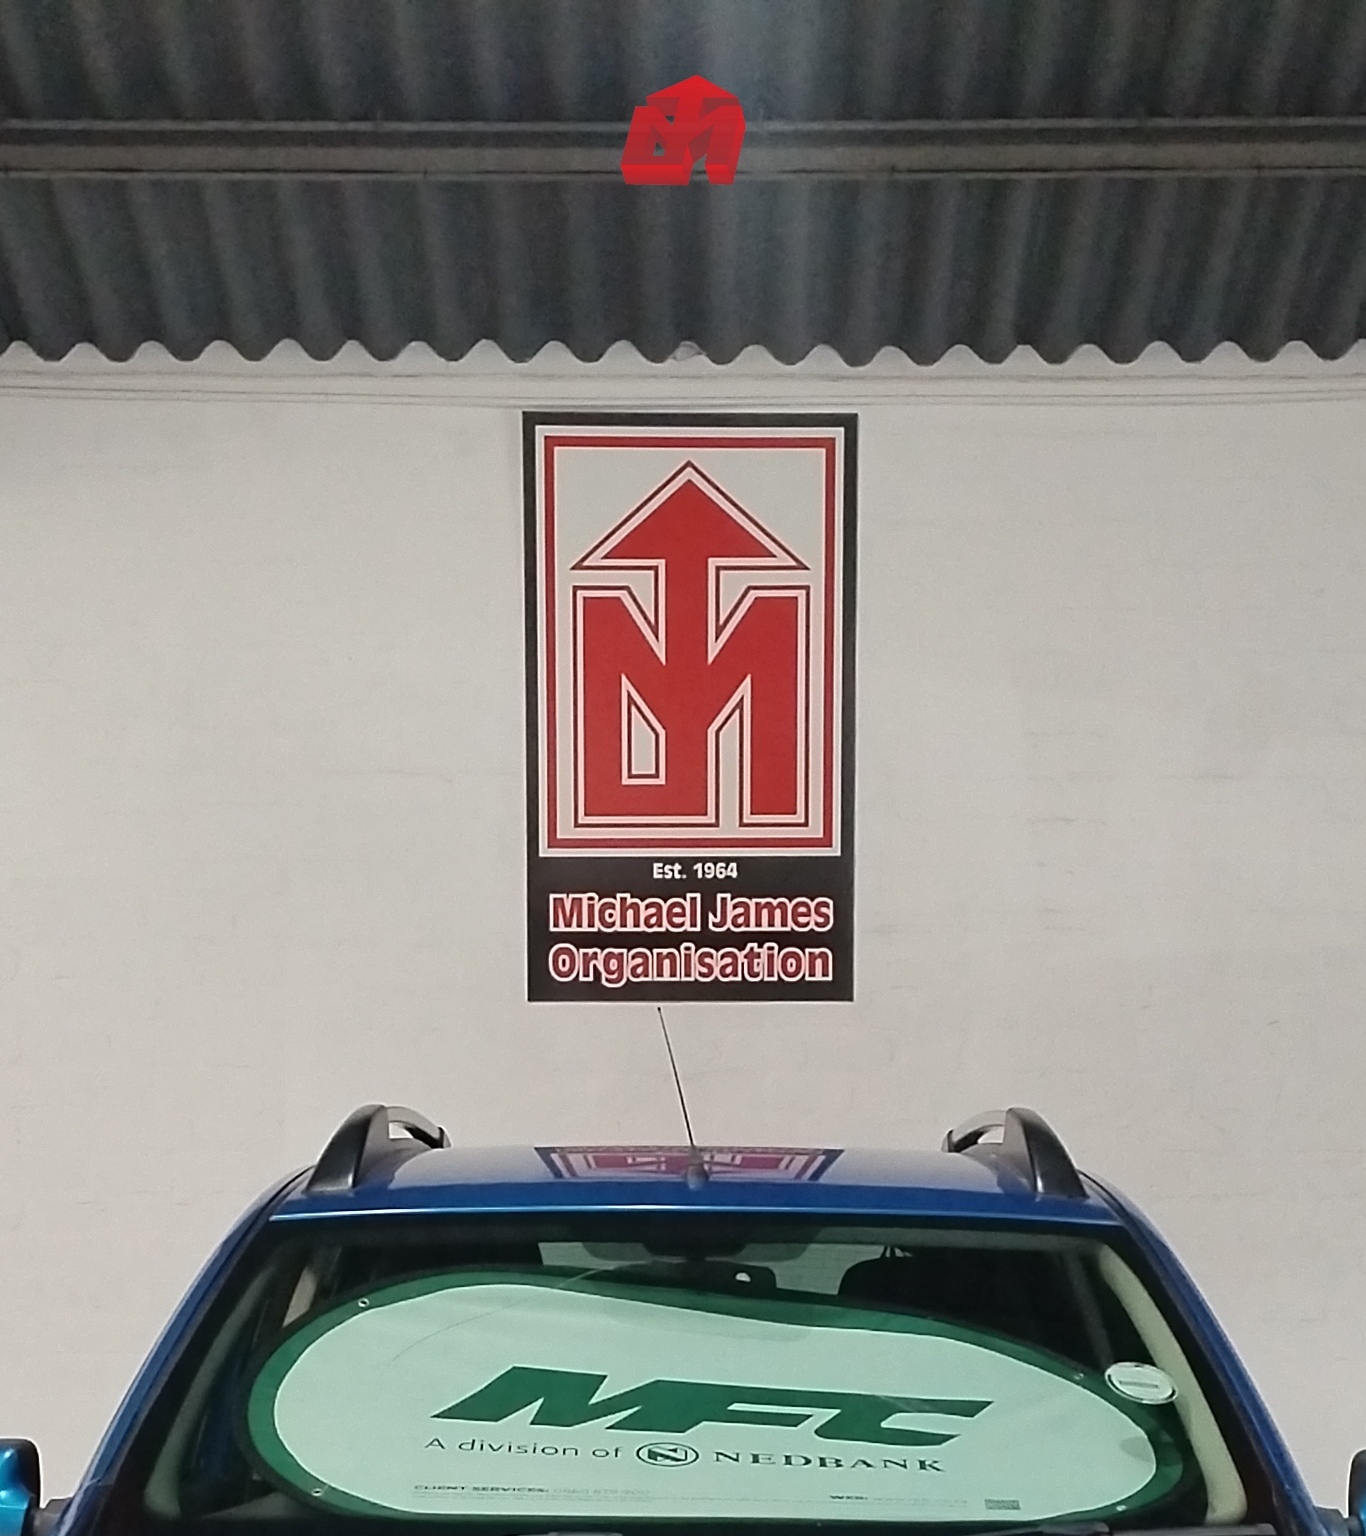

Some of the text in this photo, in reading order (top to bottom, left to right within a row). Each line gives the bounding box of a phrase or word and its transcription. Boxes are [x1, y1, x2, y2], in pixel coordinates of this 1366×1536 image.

[653, 862, 737, 879] Est. 1964
[549, 894, 833, 933] Michael James
[549, 943, 833, 985] Organisation
[430, 1366, 993, 1446] MFC
[425, 1438, 942, 1471] A division of NEDBANK
